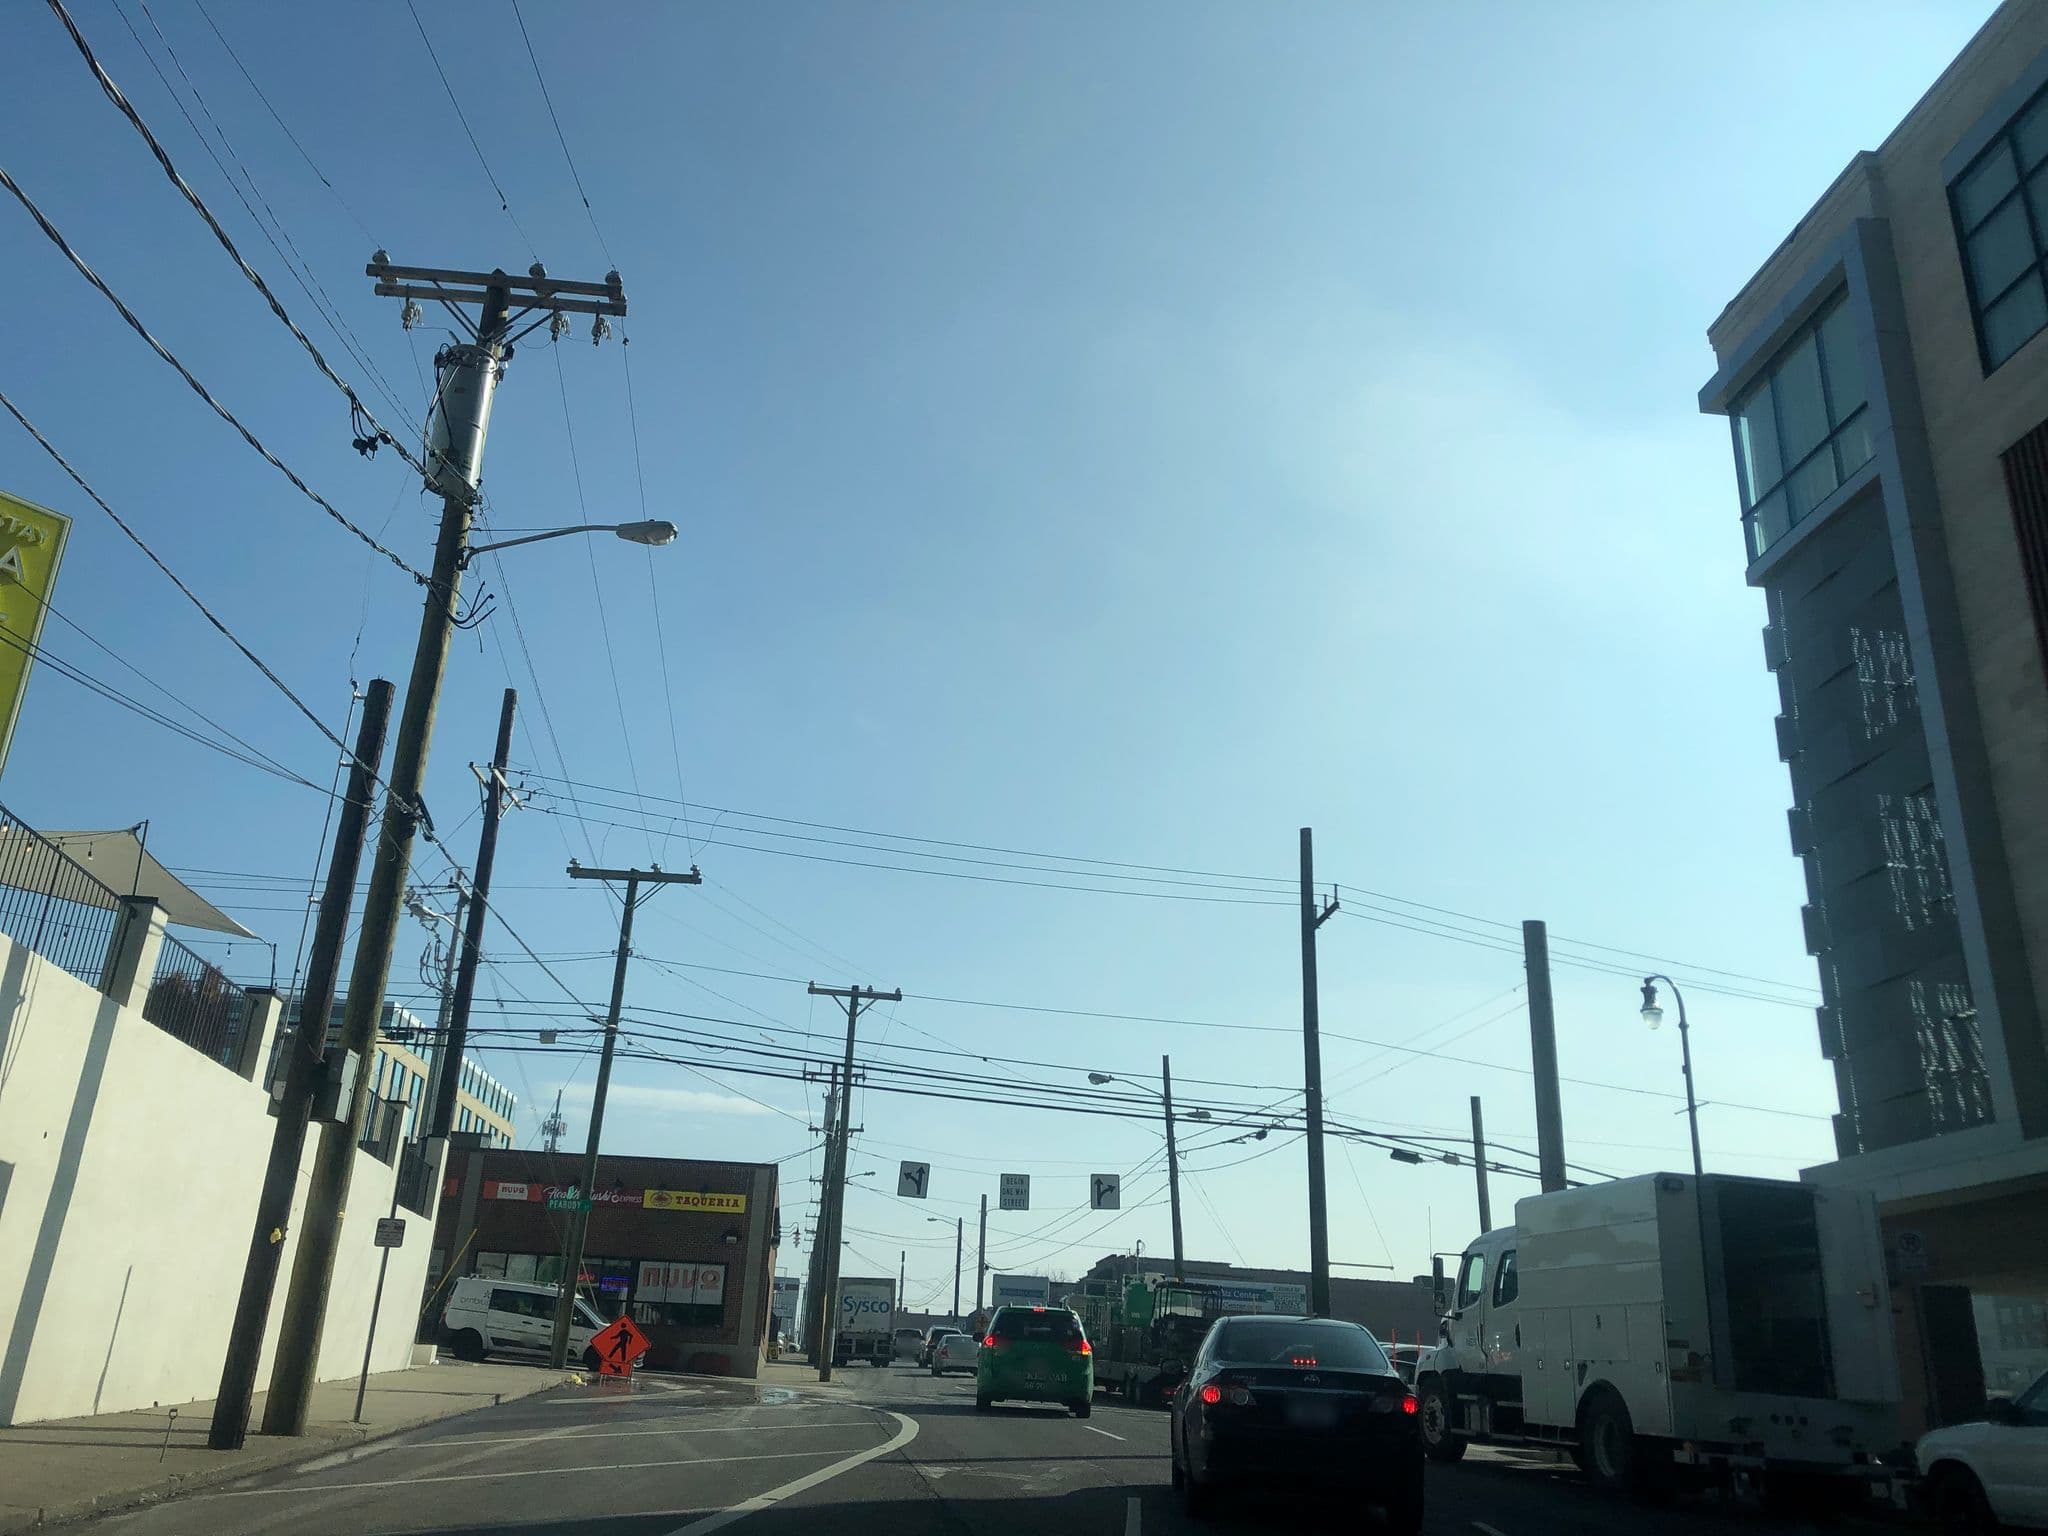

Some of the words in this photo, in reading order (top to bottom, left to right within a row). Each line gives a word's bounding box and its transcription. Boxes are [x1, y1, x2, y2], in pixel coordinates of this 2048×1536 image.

[1006, 1177, 1024, 1185] BEGIN
[549, 1200, 581, 1210] PEABODY
[675, 1195, 740, 1208] TAQUERIA
[1002, 1198, 1025, 1207] STREET
[843, 1295, 890, 1317] Sysco
